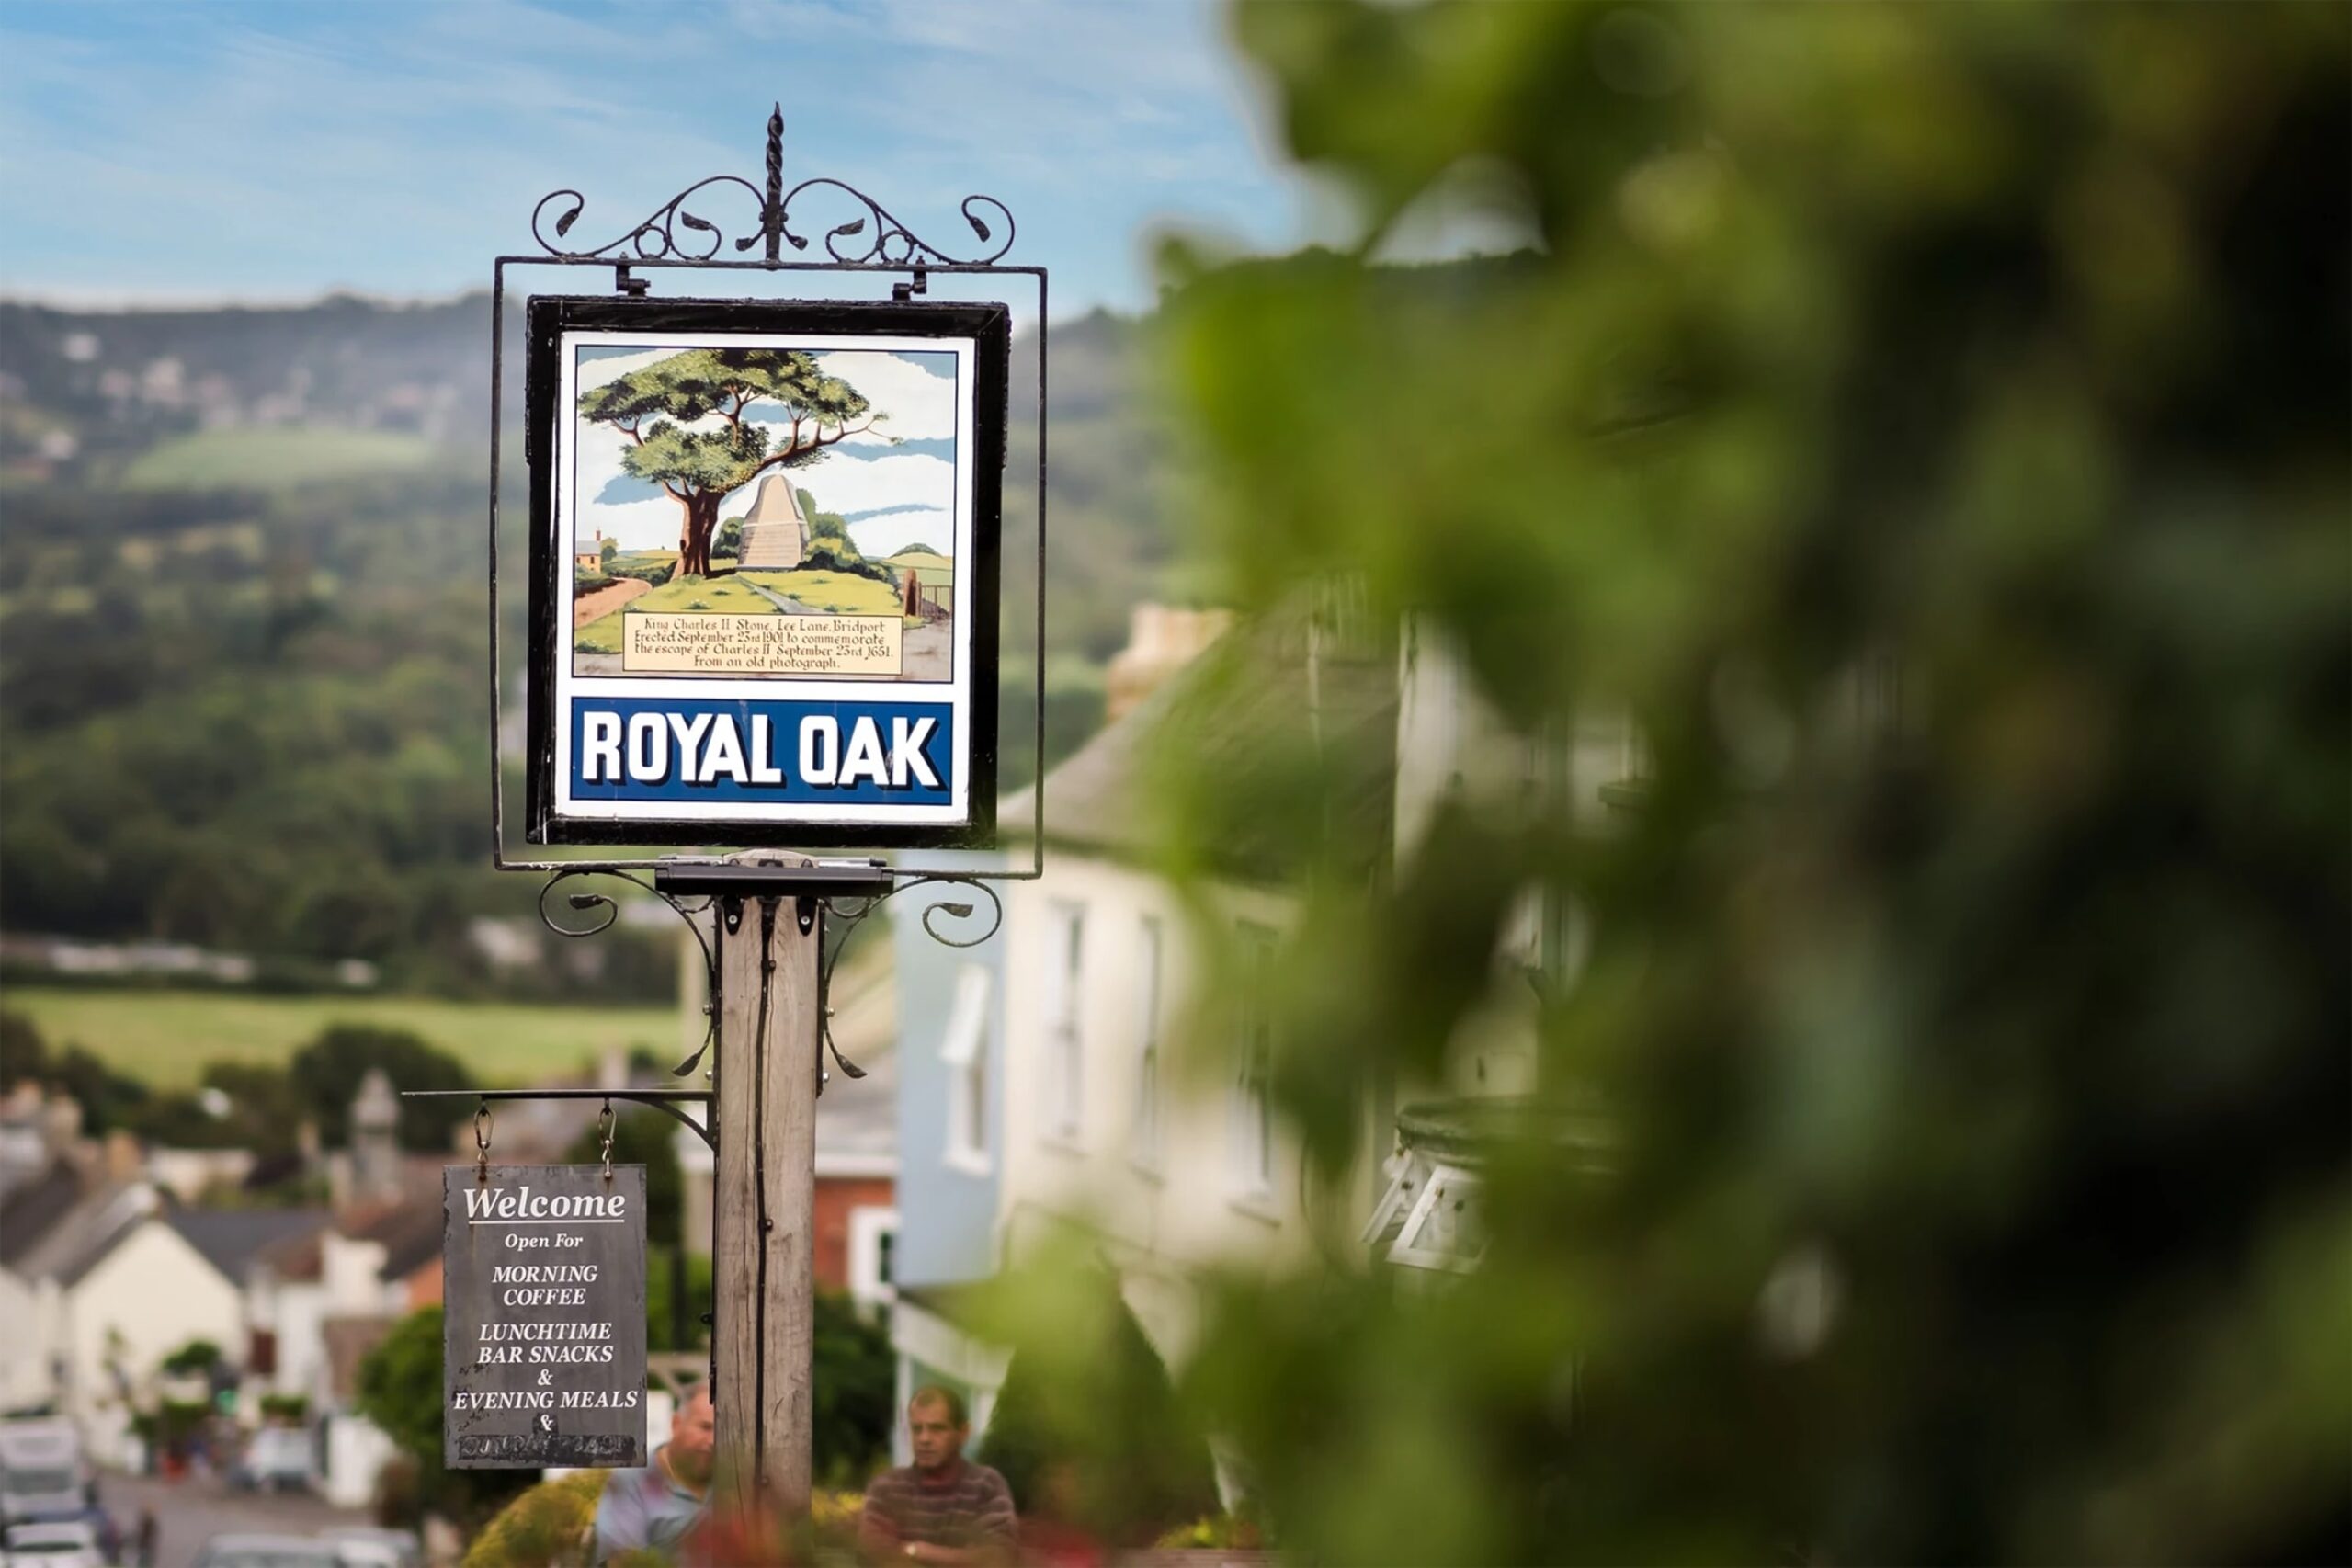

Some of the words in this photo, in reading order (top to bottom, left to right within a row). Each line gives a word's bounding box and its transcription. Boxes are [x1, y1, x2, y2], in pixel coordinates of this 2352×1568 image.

[645, 618, 669, 632] King
[674, 619, 717, 630] Charles
[722, 619, 730, 630] II
[778, 619, 795, 631] Lee
[834, 620, 885, 634] Bridport
[635, 630, 676, 642] Erected
[677, 631, 733, 643] September
[763, 632, 783, 643] 1901
[787, 632, 798, 643] to
[802, 635, 884, 644] commemorate
[635, 642, 653, 653] the
[655, 645, 692, 655] escape
[697, 644, 710, 654] of
[713, 644, 759, 654] Charles
[762, 644, 770, 654] II
[777, 644, 832, 657] September
[695, 655, 722, 666] From
[727, 658, 742, 666] an
[746, 656, 765, 667] old
[770, 656, 840, 670] photograph.
[582, 711, 782, 783] ROYAL
[800, 716, 938, 786] OAK
[463, 1187, 625, 1218] Welcome
[505, 1233, 550, 1251] Open
[554, 1233, 584, 1247] For
[492, 1265, 597, 1283] MORNING
[504, 1289, 586, 1306] COFFEE
[479, 1323, 611, 1341] LUNCHTIME
[477, 1347, 523, 1364] BAR
[529, 1346, 614, 1363] SNACKS
[538, 1369, 553, 1386] &
[454, 1392, 554, 1410] EVENING
[560, 1391, 638, 1408] MEALS
[540, 1415, 553, 1431] &
